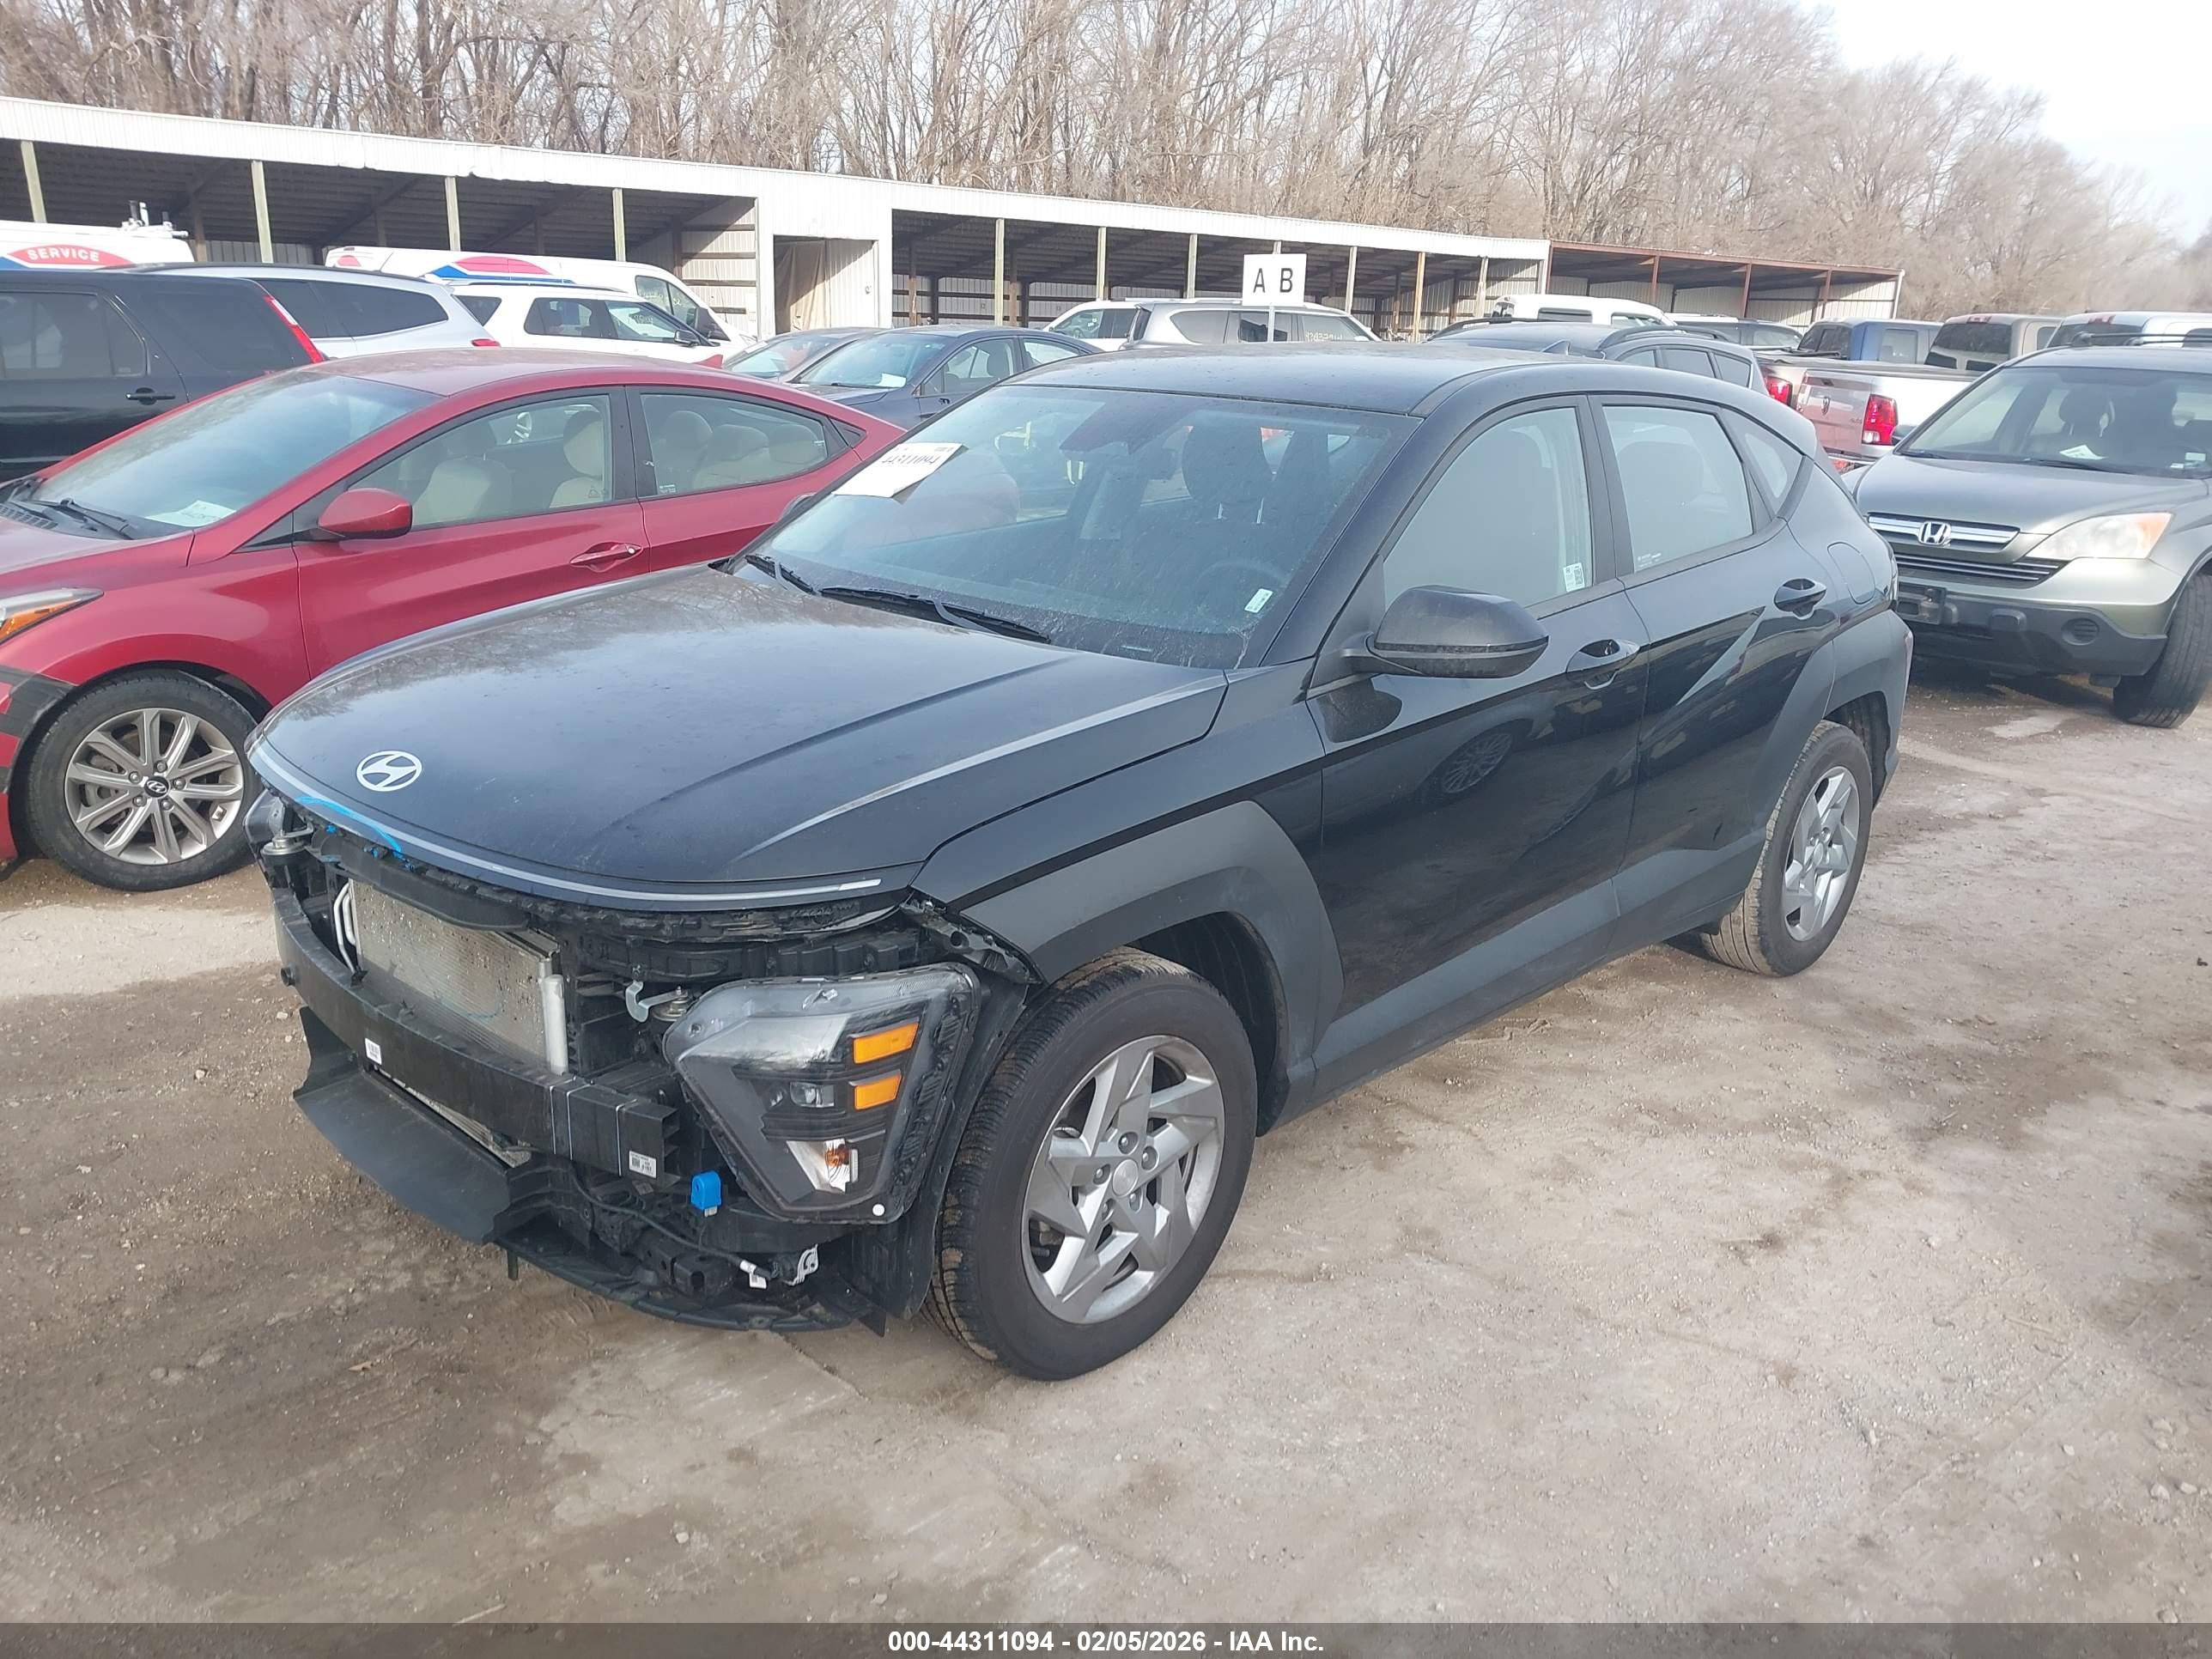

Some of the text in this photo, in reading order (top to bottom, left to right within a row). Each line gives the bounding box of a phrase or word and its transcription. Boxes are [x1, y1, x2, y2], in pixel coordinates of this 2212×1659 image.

[27, 247, 100, 262] SERVICE
[1253, 267, 1293, 294] A B
